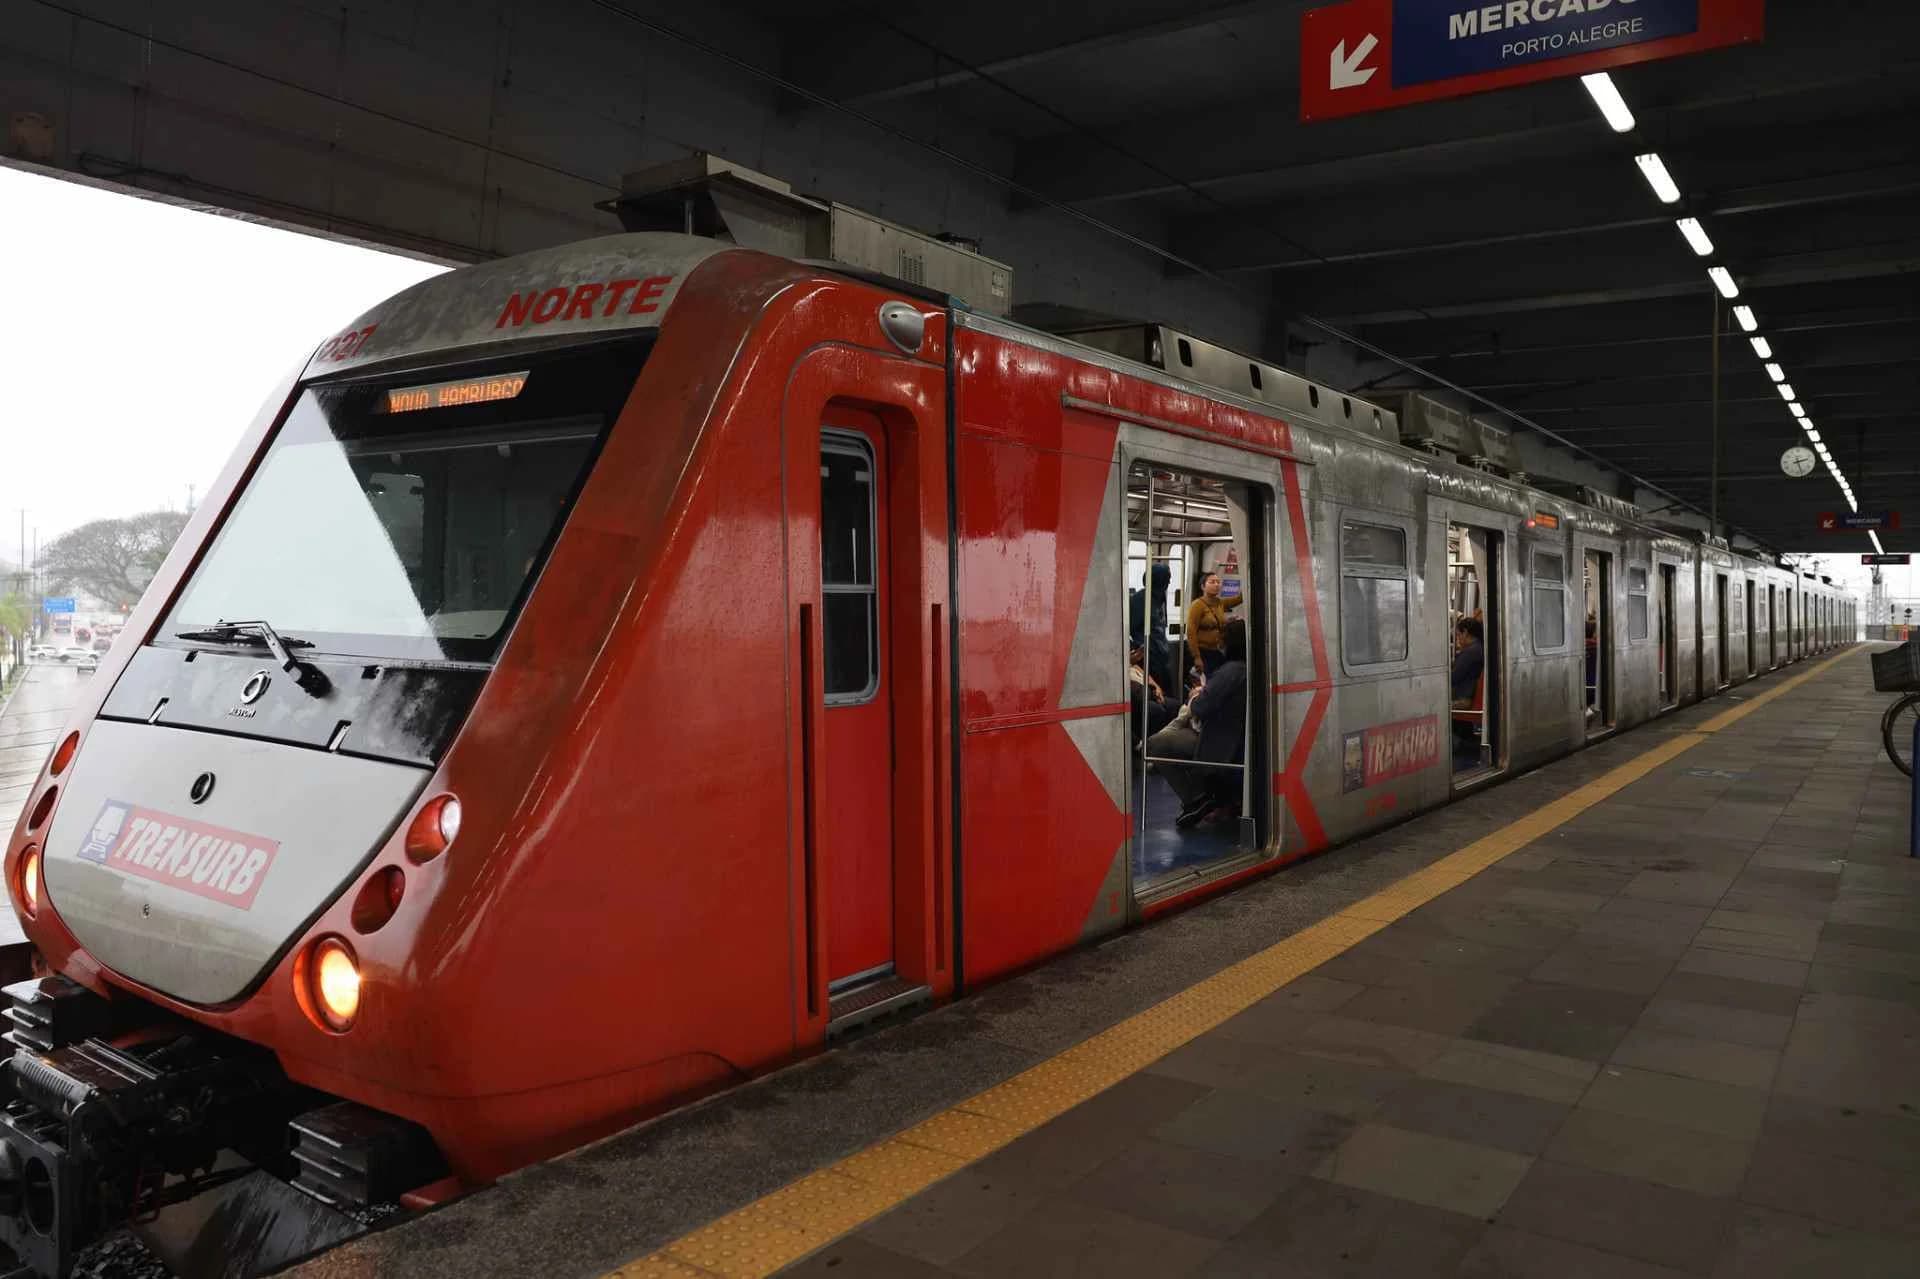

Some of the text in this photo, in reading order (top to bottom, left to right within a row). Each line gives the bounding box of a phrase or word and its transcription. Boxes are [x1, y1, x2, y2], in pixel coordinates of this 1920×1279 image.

[1502, 17, 1644, 58] PORTO ALEGRE
[496, 276, 672, 328] NORTE
[1368, 724, 1436, 776] TRENSURB
[115, 817, 268, 895] TRENSURB
